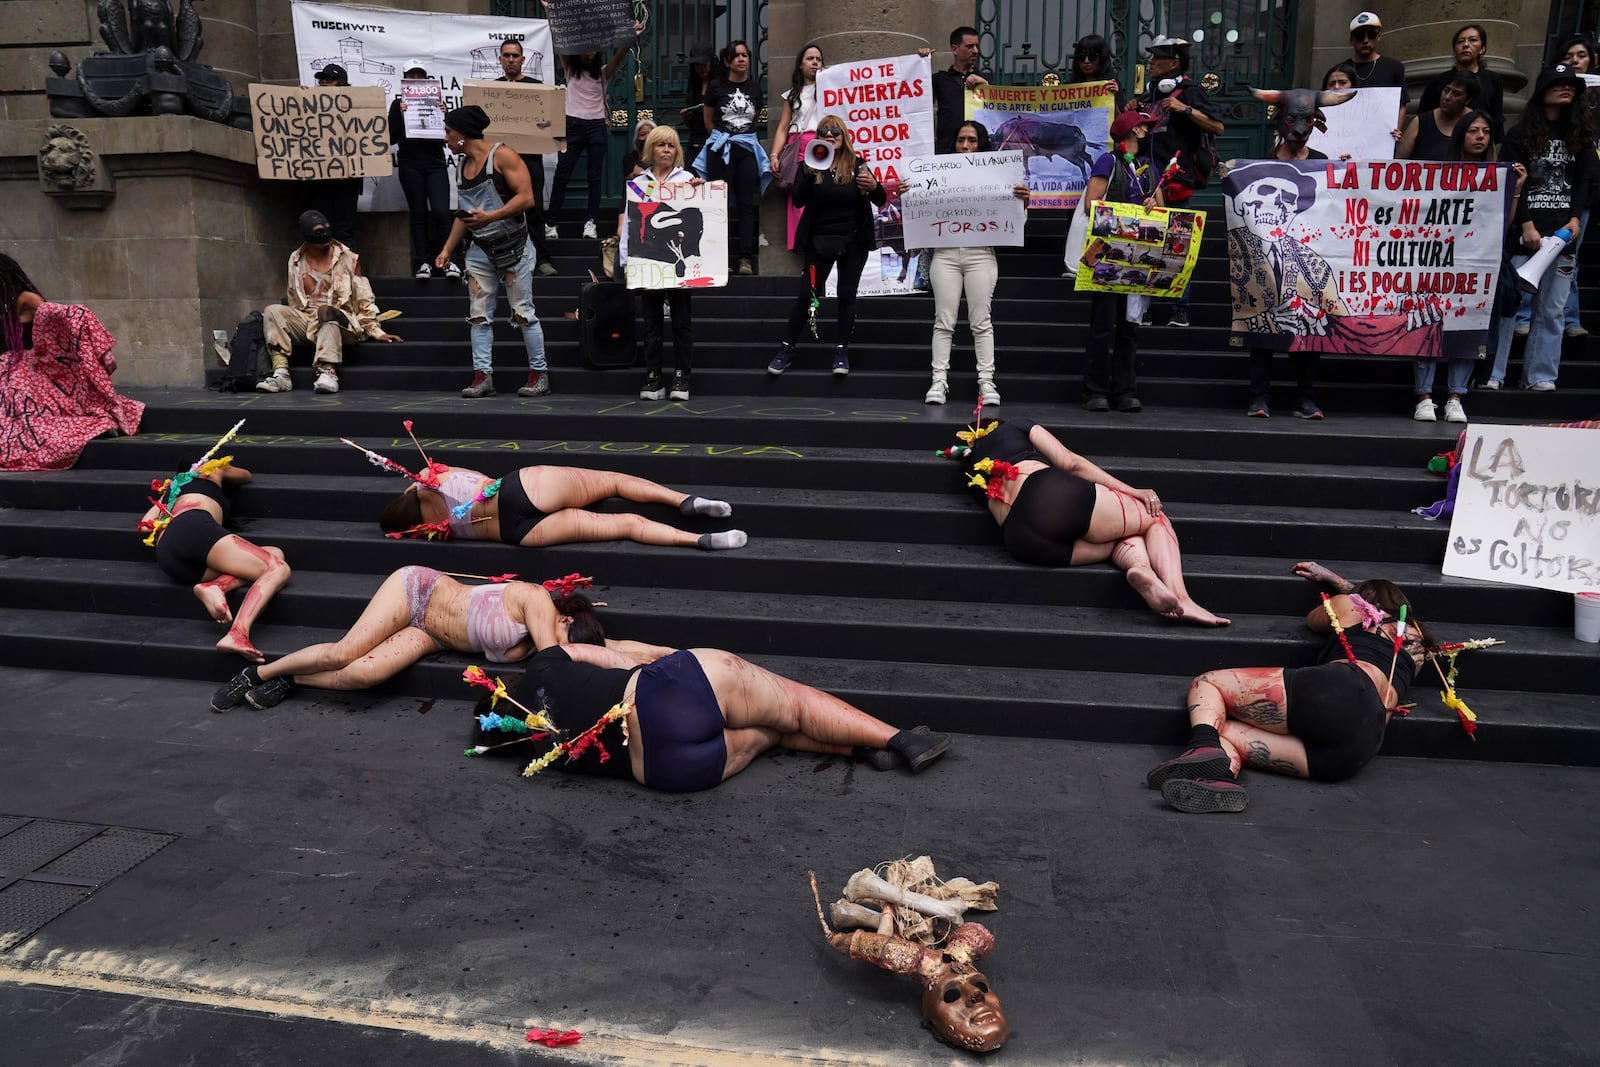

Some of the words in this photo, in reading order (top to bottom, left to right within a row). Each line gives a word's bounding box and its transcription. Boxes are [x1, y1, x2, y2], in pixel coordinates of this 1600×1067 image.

[312, 20, 385, 33] AUSCHWITZ
[850, 67, 873, 81] NO
[878, 64, 894, 77] TE
[256, 92, 352, 116] CUANDO
[824, 79, 924, 107] DIVIERTAS
[990, 89, 1037, 102] MUERTE
[1040, 89, 1049, 101] Y
[1052, 85, 1109, 100] TORTURA
[848, 107, 880, 122] CON
[885, 105, 901, 119] EL
[983, 102, 995, 110] NO
[997, 102, 1007, 111] ES
[1040, 103, 1049, 111] NI
[1051, 100, 1092, 111] CULTURA
[261, 135, 325, 158] SUFRE
[876, 147, 902, 161] LOS
[909, 158, 961, 173] GERARDO
[965, 155, 1023, 167] VILLANUEVA
[1042, 181, 1063, 191] VIDA
[1325, 162, 1359, 190] LA
[1368, 162, 1498, 192] TORTURA
[1345, 198, 1369, 225] NO
[1374, 206, 1394, 225] es
[1397, 198, 1421, 225] NI
[1424, 198, 1475, 225] ARTE
[1353, 239, 1370, 267] NI
[1376, 241, 1455, 267] CULTURA
[1372, 271, 1412, 294] POCA
[1467, 435, 1526, 481] LA
[1513, 517, 1572, 545] NO
